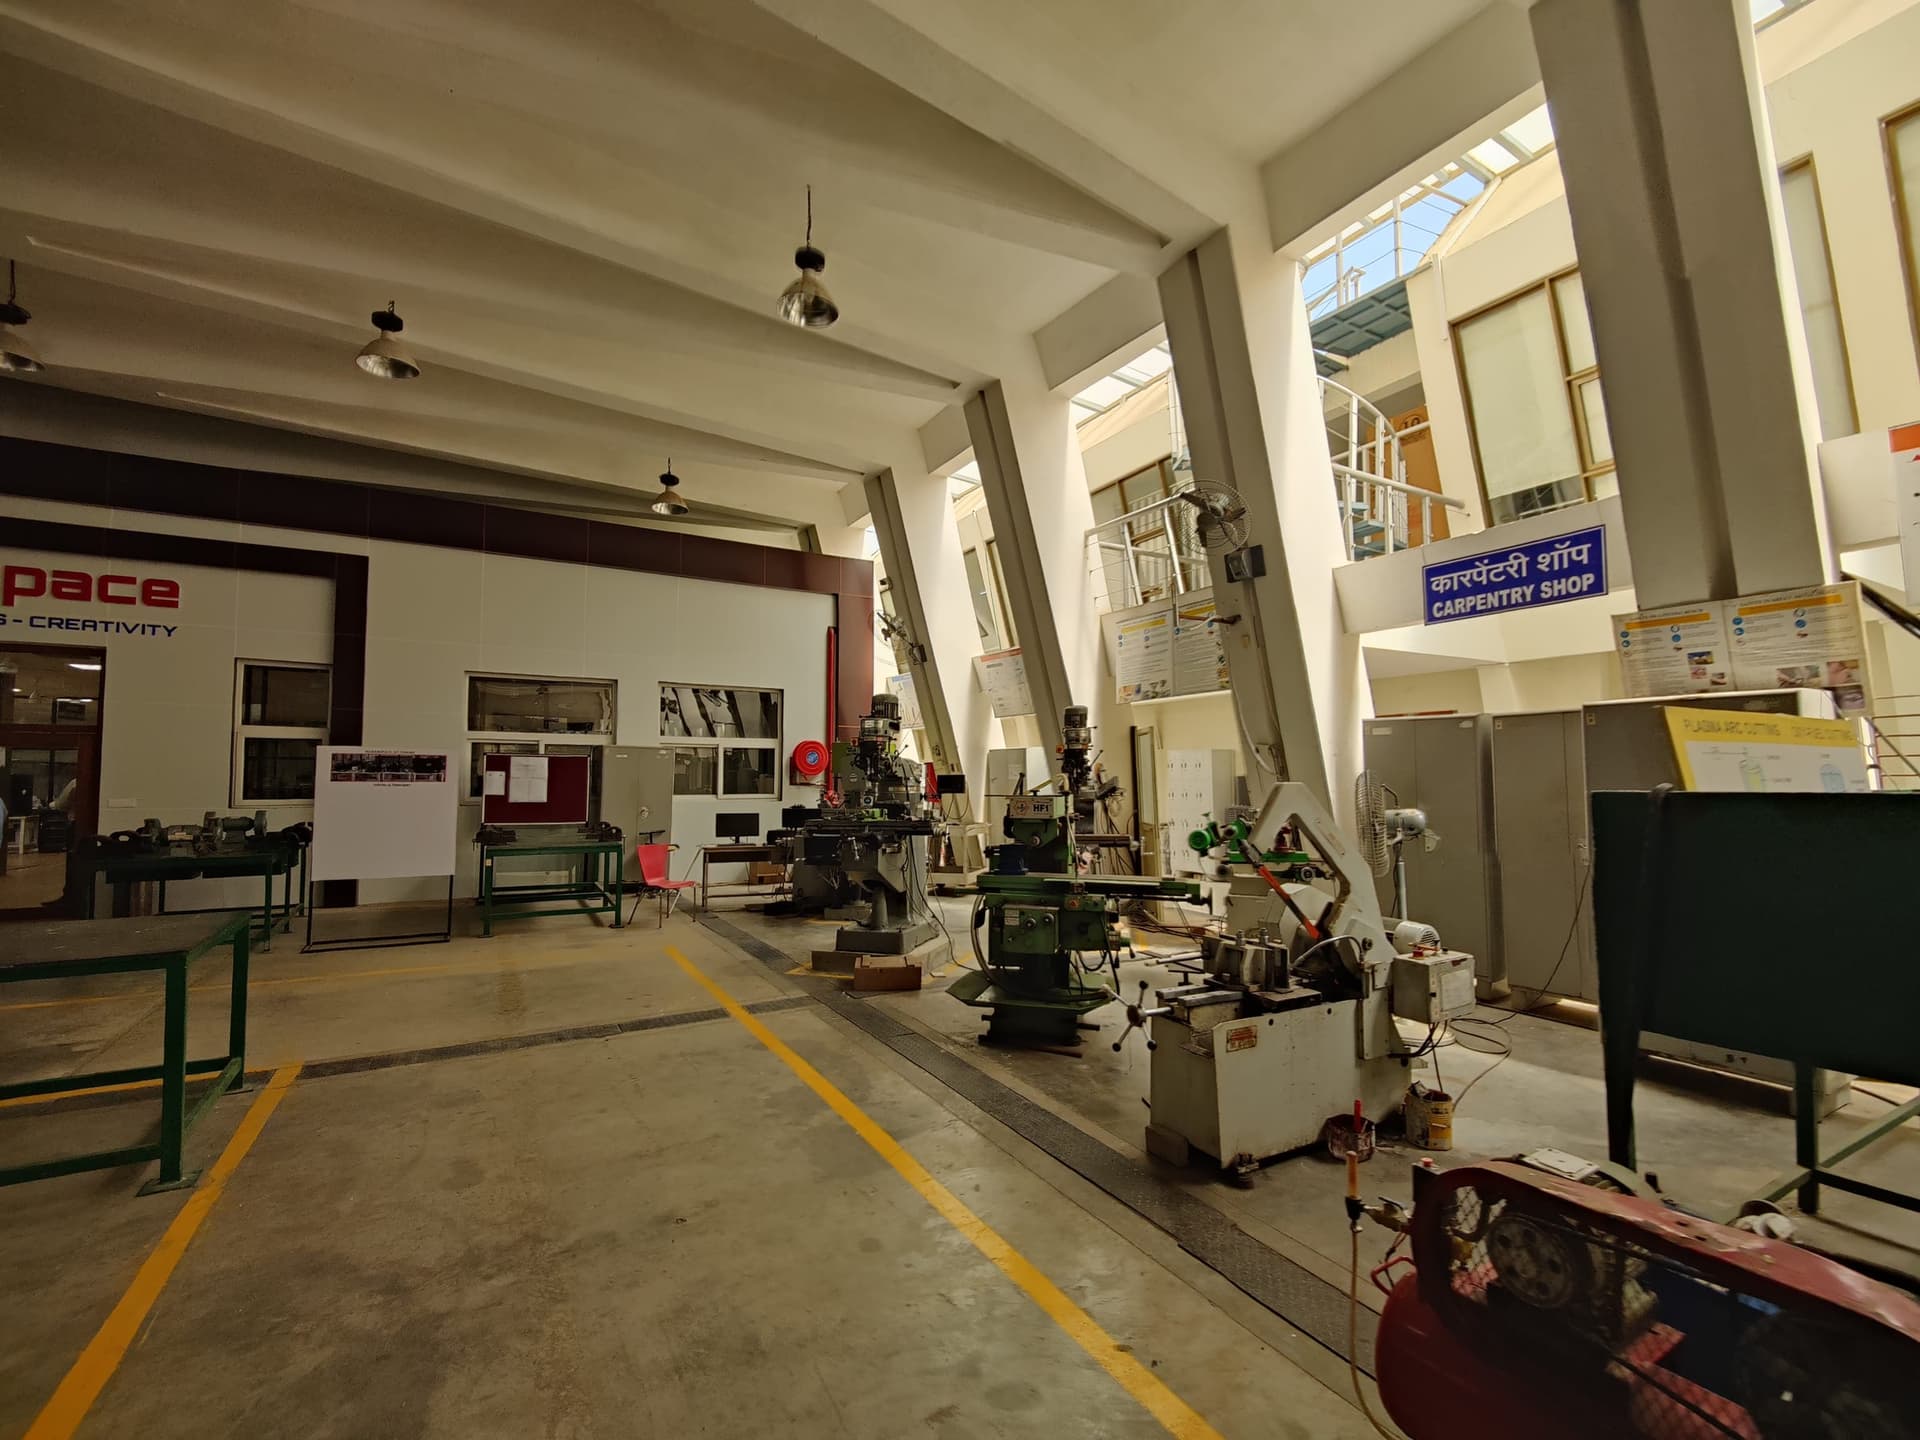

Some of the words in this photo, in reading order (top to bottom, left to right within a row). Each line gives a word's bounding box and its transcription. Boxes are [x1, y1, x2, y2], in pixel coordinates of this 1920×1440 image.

[1430, 552, 1530, 594] कारपेंटरी
[1537, 541, 1592, 572] शॉप
[1432, 584, 1535, 618] CARPENTRY
[1540, 573, 1595, 599] SHOP
[29, 616, 178, 637] CREATIVITY
